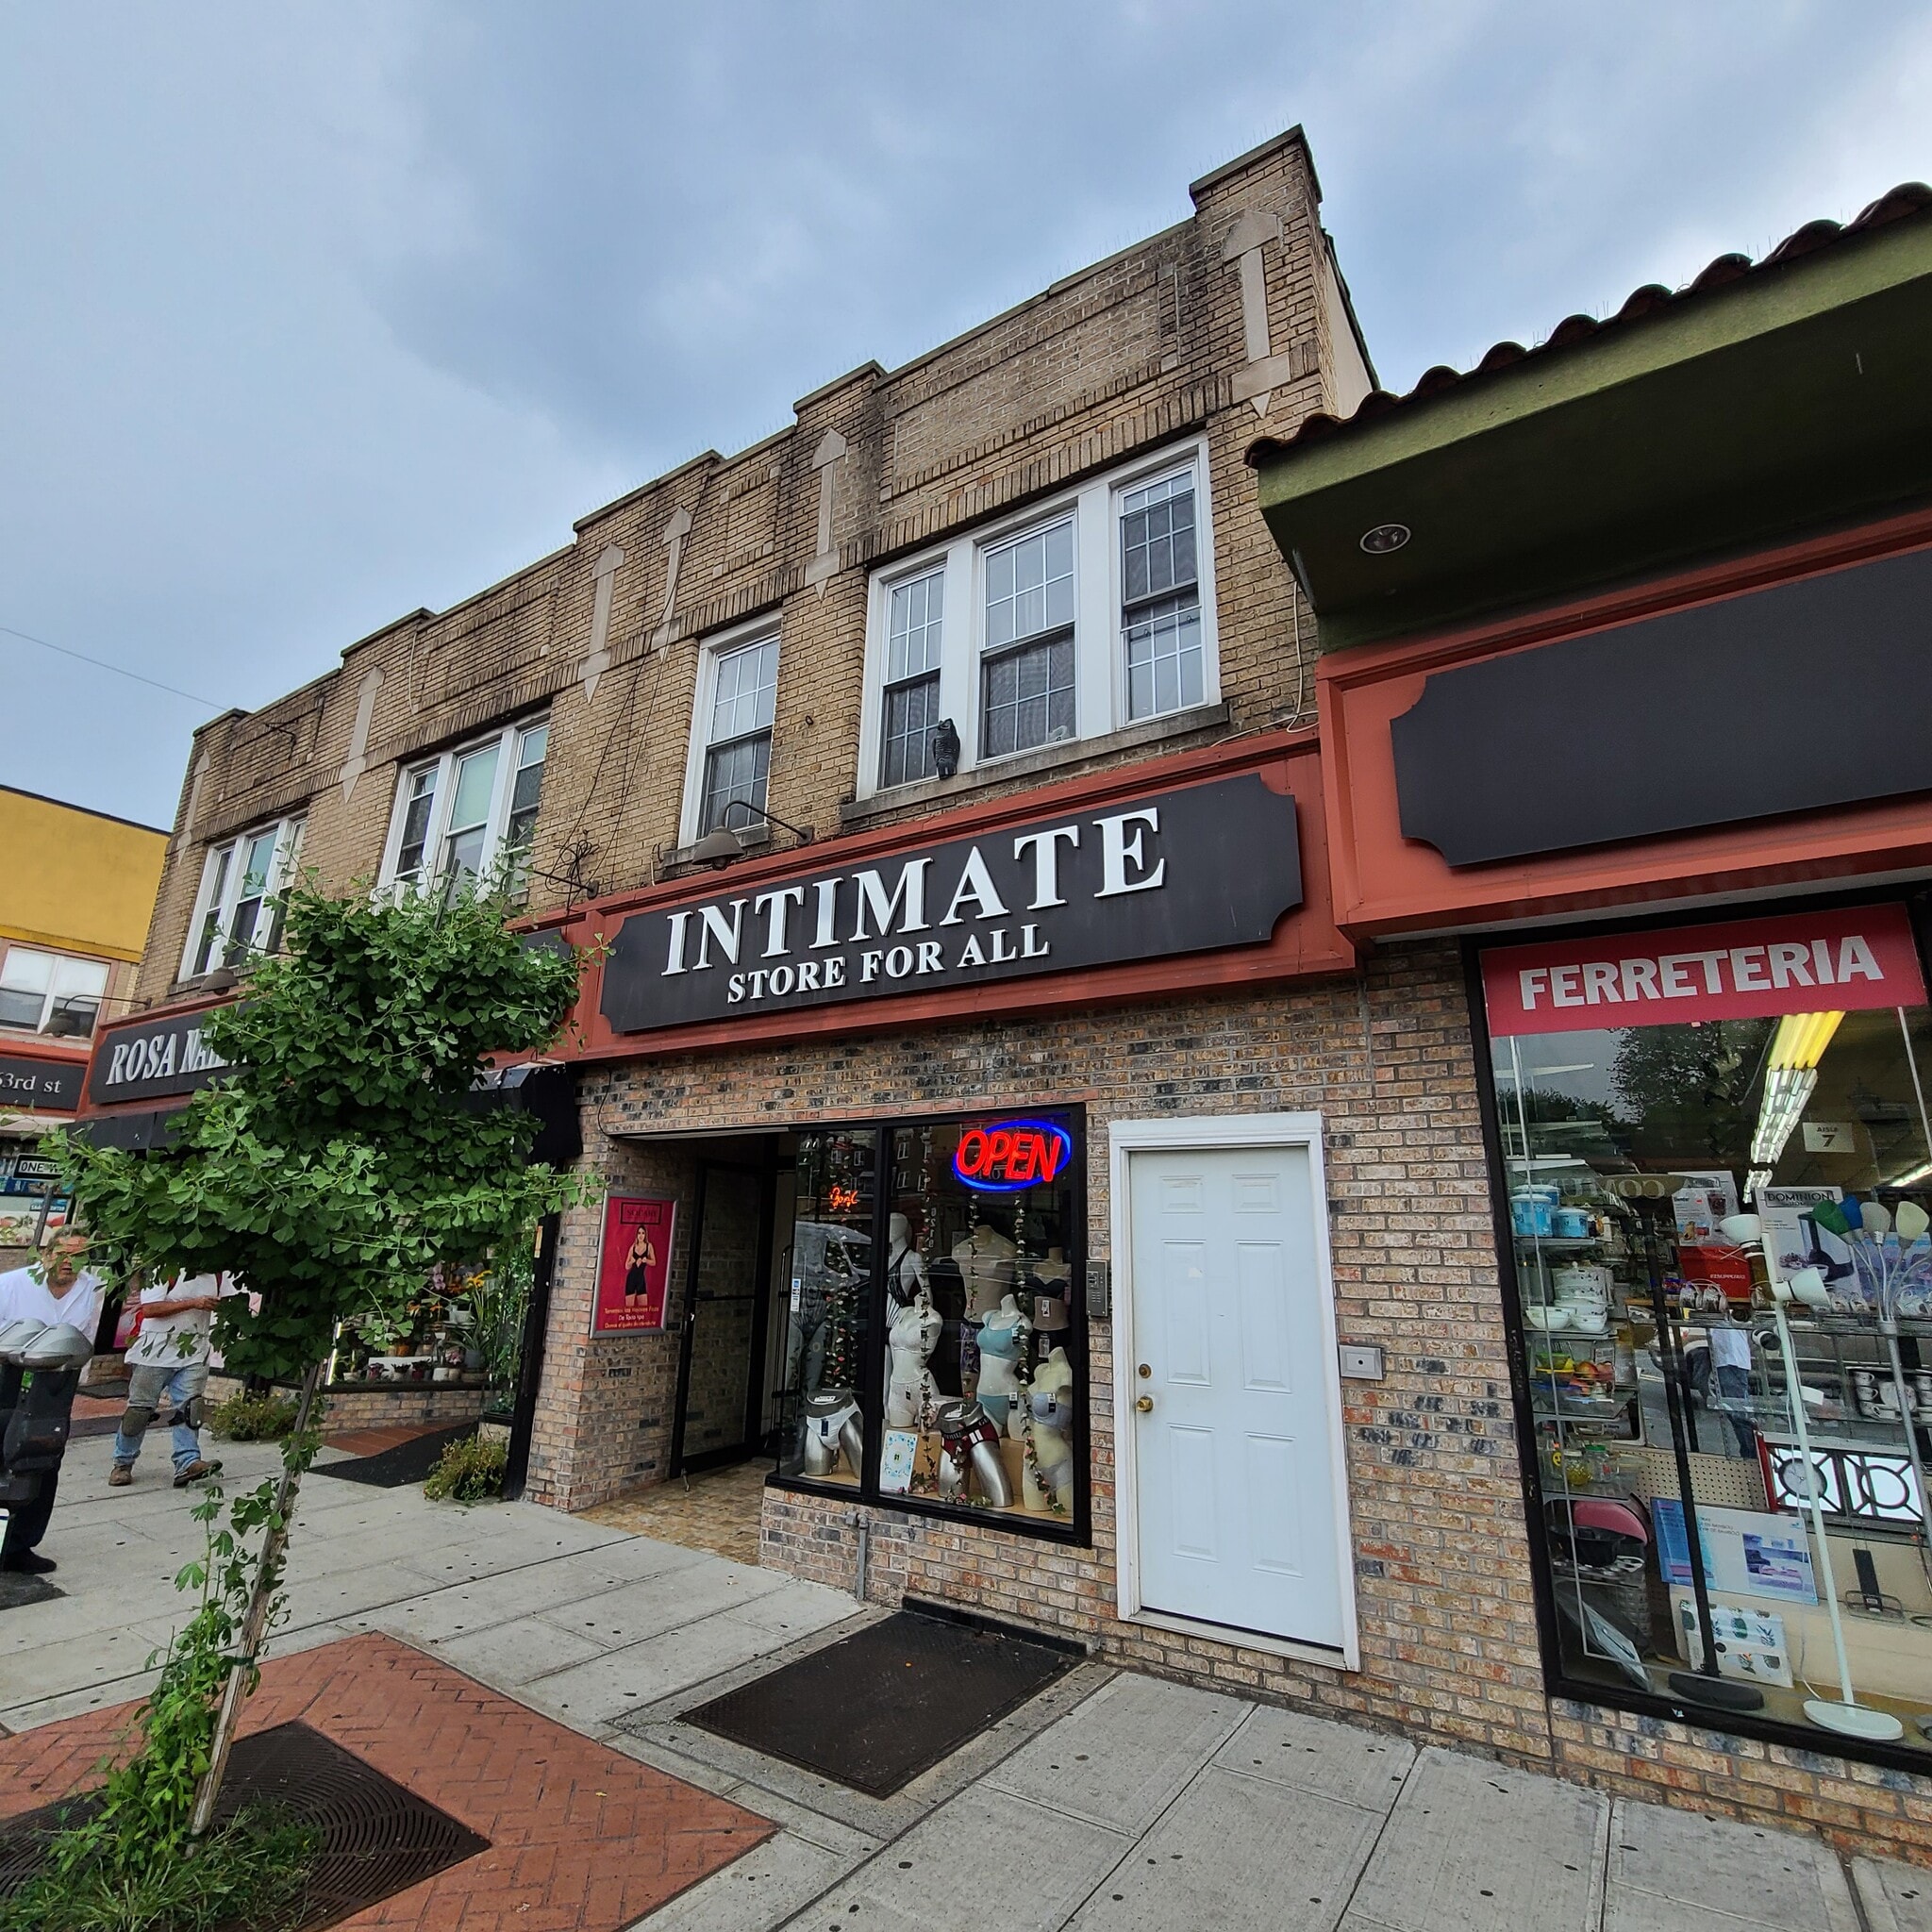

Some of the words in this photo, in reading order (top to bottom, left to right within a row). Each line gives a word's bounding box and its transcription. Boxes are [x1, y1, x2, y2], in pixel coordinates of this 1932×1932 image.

[661, 807, 1168, 978] INTIMATE
[726, 956, 848, 1005] STORE
[859, 940, 945, 984] FOR
[956, 923, 1050, 970] ALL
[1518, 935, 1885, 1010] FERRETERIA
[105, 1033, 177, 1086] ROSA
[43, 1080, 62, 1093] st
[957, 1129, 1062, 1182] OPEN
[1822, 1134, 1836, 1148] 7
[21, 1162, 45, 1174] ONE
